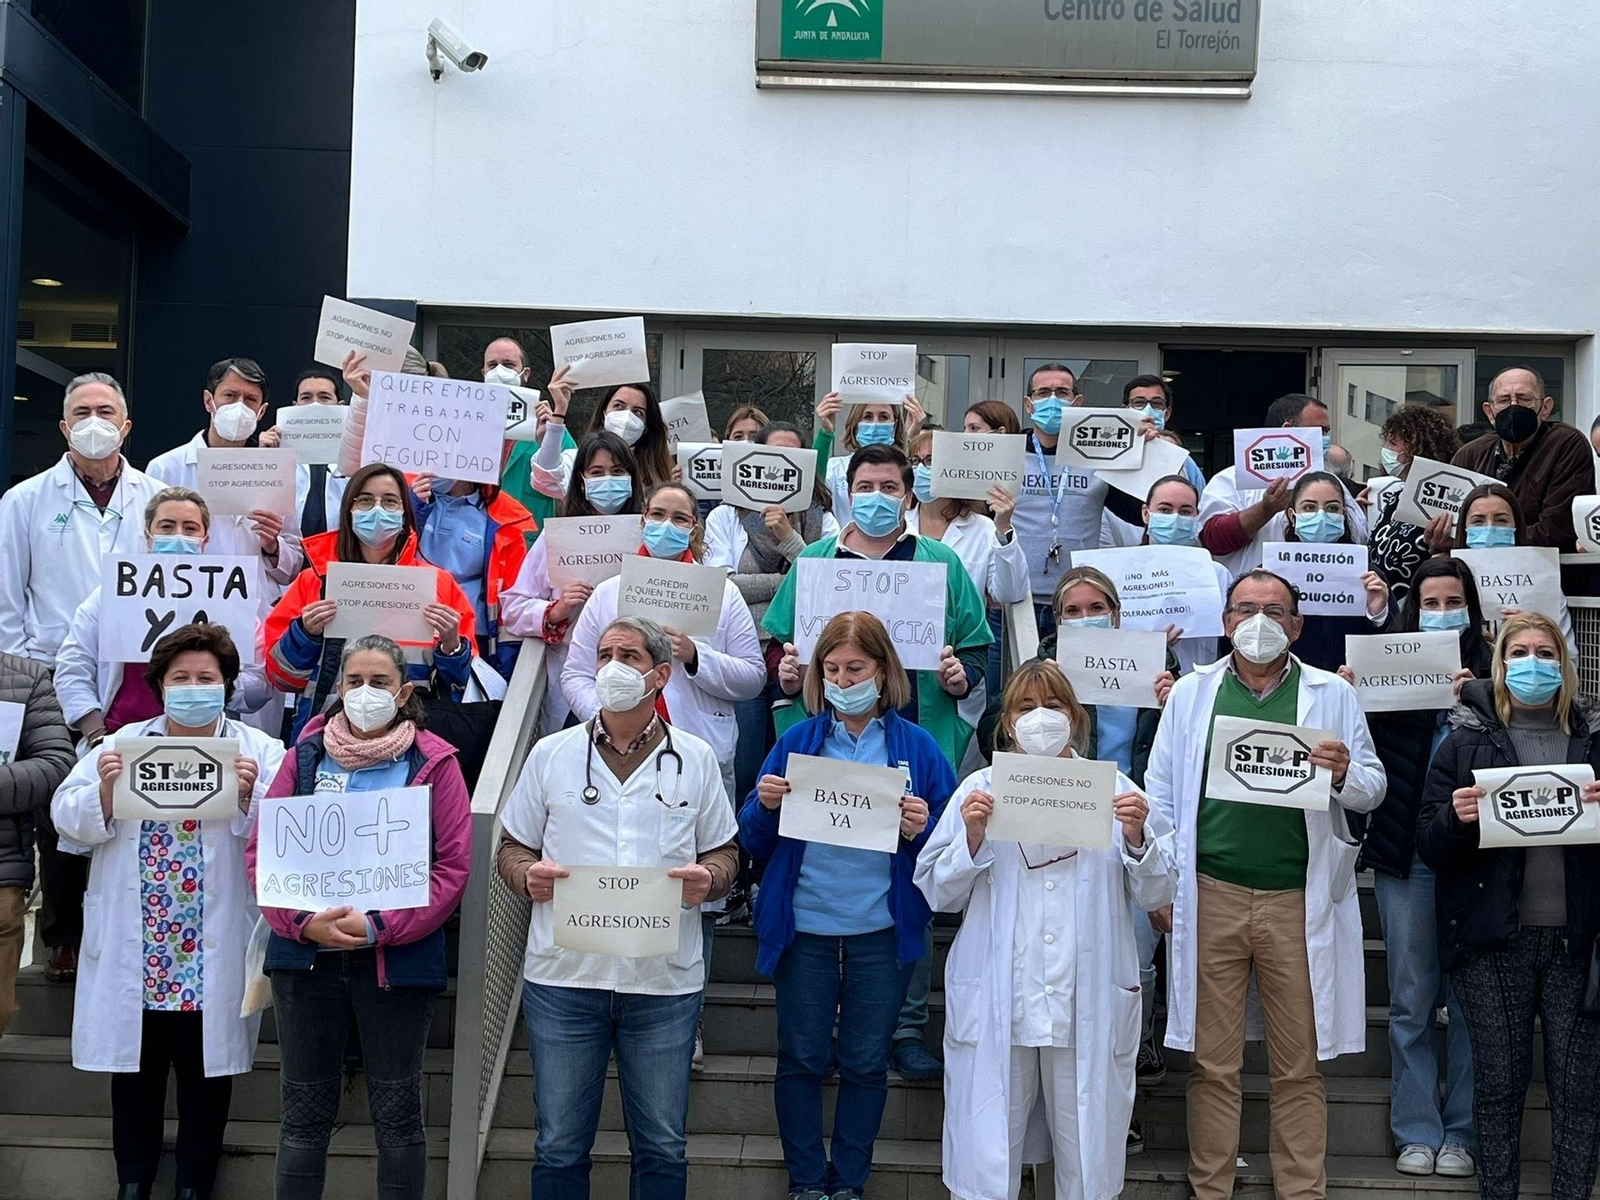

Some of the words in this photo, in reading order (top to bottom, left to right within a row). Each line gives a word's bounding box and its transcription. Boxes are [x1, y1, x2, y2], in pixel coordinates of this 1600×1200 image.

[1044, 0, 1125, 20] Centro
[1134, 0, 1163, 21] de
[1172, 0, 1242, 23] Salud
[793, 30, 817, 40] JUNTA
[820, 31, 829, 40] DE
[831, 31, 870, 41] ANDALUCIA
[1156, 30, 1170, 49] El
[1177, 29, 1240, 54] Torrejón
[331, 314, 379, 335] AGRESIONES
[378, 329, 393, 338] NO
[325, 330, 345, 340] STOP
[344, 336, 393, 356] AGRESIONES
[564, 333, 613, 346] AGRESIONES
[563, 354, 583, 363] STOP
[584, 347, 633, 360] AGRESIONES
[860, 350, 888, 360] STOP
[380, 374, 497, 401] QUEREMOS
[839, 376, 909, 386] AGRESIONES
[386, 402, 486, 422] TRABAJAR
[668, 417, 689, 430] STA
[302, 432, 342, 440] AGRESIONE
[413, 423, 461, 443] CON
[963, 441, 994, 451] STOP
[1076, 440, 1128, 449] AGRESIONES
[371, 444, 494, 472] SEGURIDAD
[211, 463, 264, 471] AGRESIONES
[265, 463, 278, 471] NO
[1253, 460, 1305, 471] AGRESIONES
[940, 468, 1017, 481] AGRESIONES
[739, 480, 796, 492] AGRESIONES
[1420, 497, 1461, 513] AGRESIO
[579, 524, 611, 535] STOP
[557, 553, 623, 566] AGRESION
[1278, 551, 1290, 562] LA
[1294, 552, 1354, 565] AGRESIÓN
[117, 561, 248, 600] BASTA
[1151, 570, 1169, 578] MÁS
[1306, 572, 1325, 582] NO
[1481, 574, 1534, 587] BASTA
[341, 580, 400, 591] AGRESIONES
[402, 583, 416, 591] NO
[646, 577, 689, 590] AGREDIR
[834, 569, 910, 595] STOP
[1122, 580, 1175, 592] AGRESIONES!!
[634, 586, 663, 597] QUIEN
[665, 591, 677, 599] TE
[679, 592, 708, 602] CUIDA
[1299, 591, 1355, 604] OLUCIÓN
[1497, 592, 1519, 605] YA
[337, 599, 361, 607] STOP
[362, 599, 420, 610] AGRESIONES
[625, 594, 638, 603] ES
[638, 597, 692, 611] AGREDIRTE
[692, 604, 700, 612] A
[1120, 608, 1164, 618] OLERANCIA
[799, 615, 937, 645] VICIA
[1384, 642, 1421, 655] STOP
[1084, 655, 1138, 672] BASTA
[1099, 675, 1121, 690] YA
[1359, 673, 1453, 687] AGRESIONES
[1234, 763, 1307, 779] AGRESIONES
[140, 782, 215, 792] AGRESIONES
[1008, 774, 1074, 787] AGRESIONES
[1076, 780, 1092, 788] NO
[814, 788, 872, 810] BASTA
[1002, 795, 1030, 805] STOP
[1030, 798, 1097, 811] AGRESIONES
[1505, 806, 1575, 820] AGRESIONES
[829, 812, 851, 829] YA
[276, 803, 346, 858] NO
[263, 860, 428, 898] AGRESIONES
[598, 876, 639, 890] STOP
[566, 913, 671, 929] AGRESIONES
